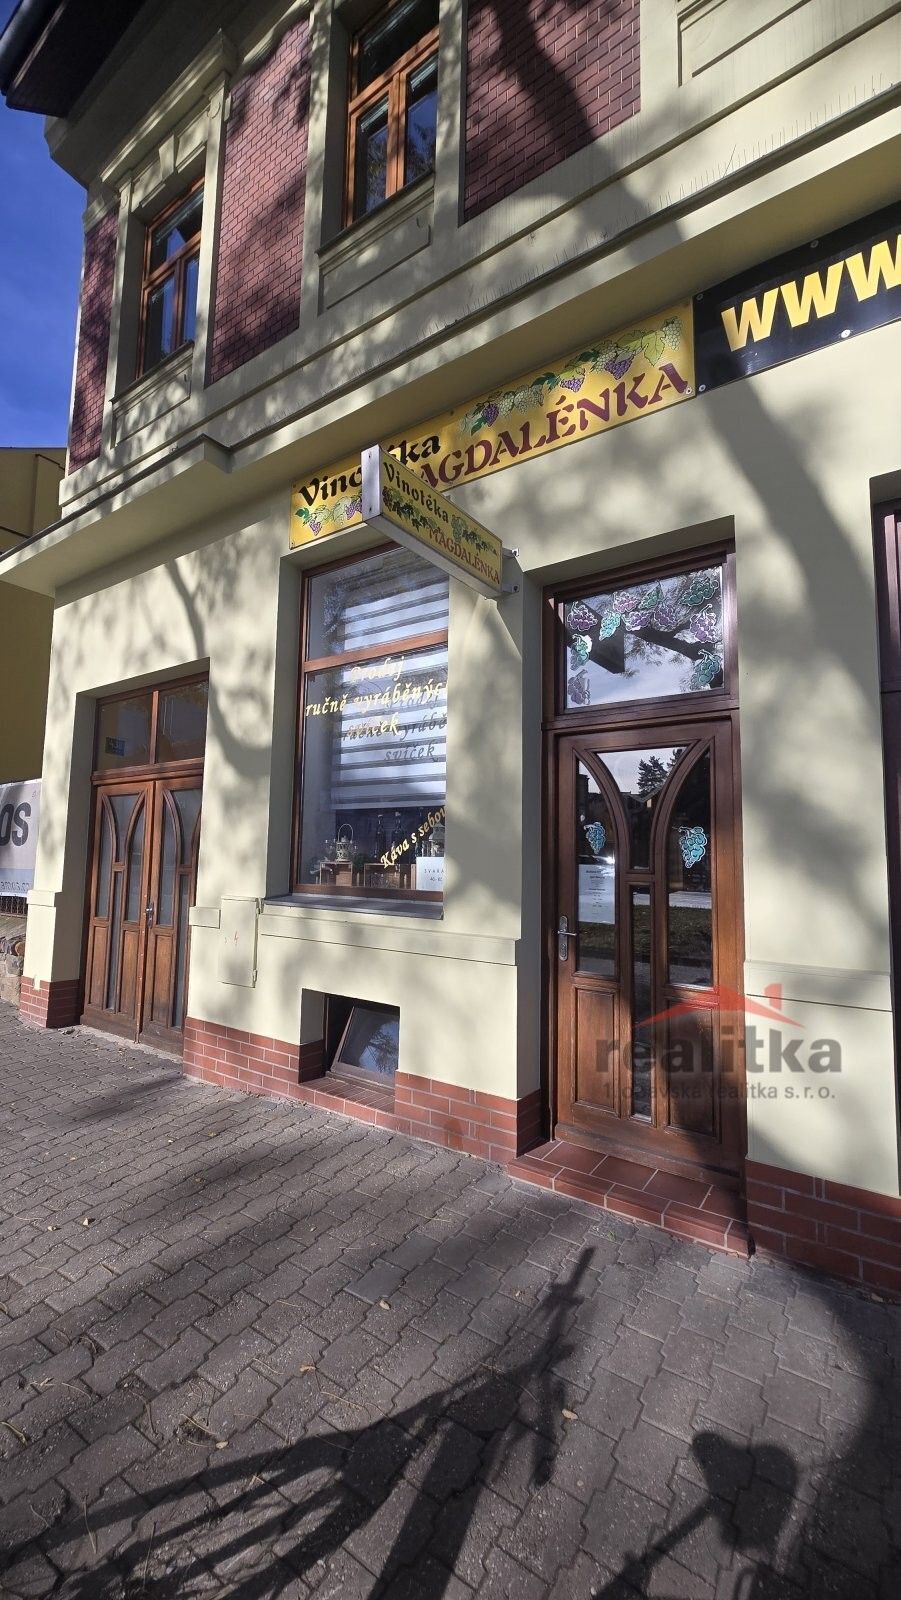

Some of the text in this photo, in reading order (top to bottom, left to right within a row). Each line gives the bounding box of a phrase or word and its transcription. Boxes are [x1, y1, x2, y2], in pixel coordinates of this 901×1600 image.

[421, 363, 689, 489] AGDALÉNKA
[299, 435, 441, 507] Vinoka
[383, 462, 449, 523] Vinotéka
[428, 527, 500, 585] MAGDALÉNKA
[305, 694, 349, 717] ručně
[381, 839, 410, 869] Káva
